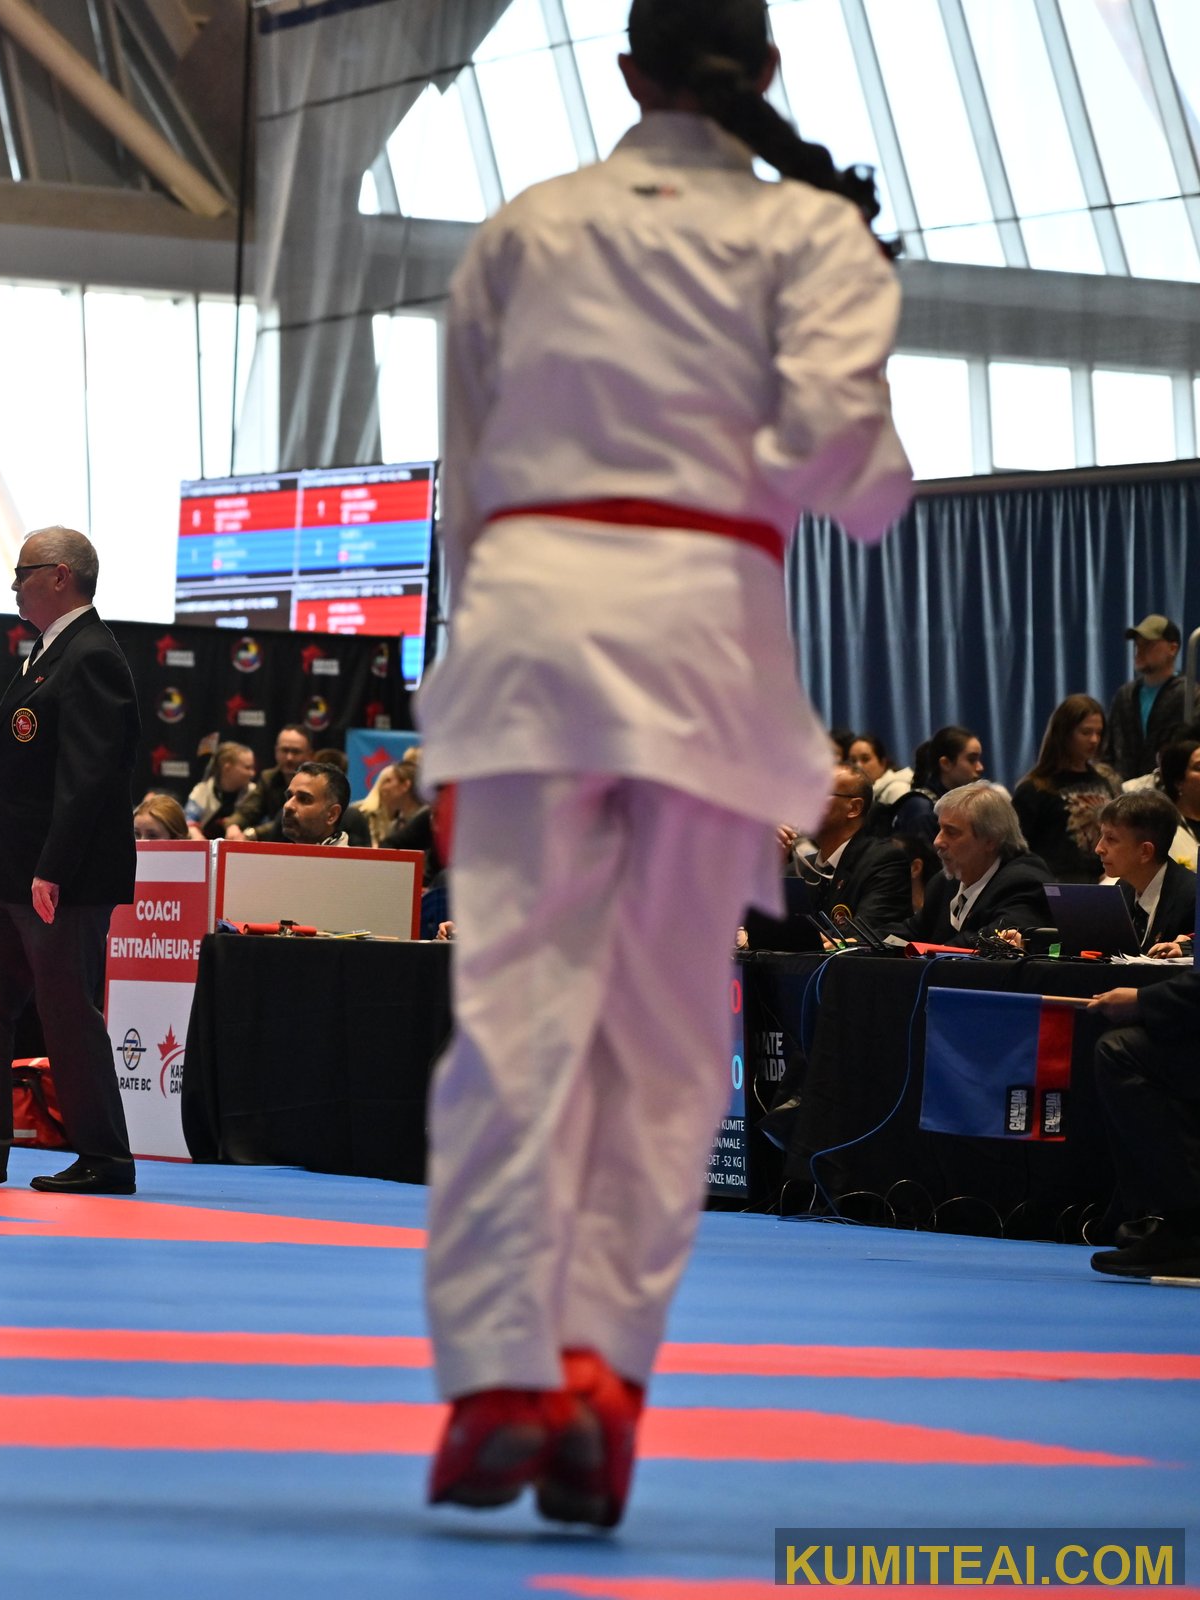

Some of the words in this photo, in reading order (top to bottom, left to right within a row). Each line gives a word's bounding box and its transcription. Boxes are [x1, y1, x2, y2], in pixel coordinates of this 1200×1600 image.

[136, 900, 181, 922] COACH
[731, 1054, 743, 1090] 0
[141, 1078, 152, 1091] BC
[1008, 1089, 1022, 1131] CANADA
[1044, 1092, 1057, 1133] CANADA
[721, 1120, 745, 1131] KUMITE
[721, 1155, 732, 1167] -52
[732, 1156, 742, 1167] KG
[726, 1174, 747, 1187] MEDAL
